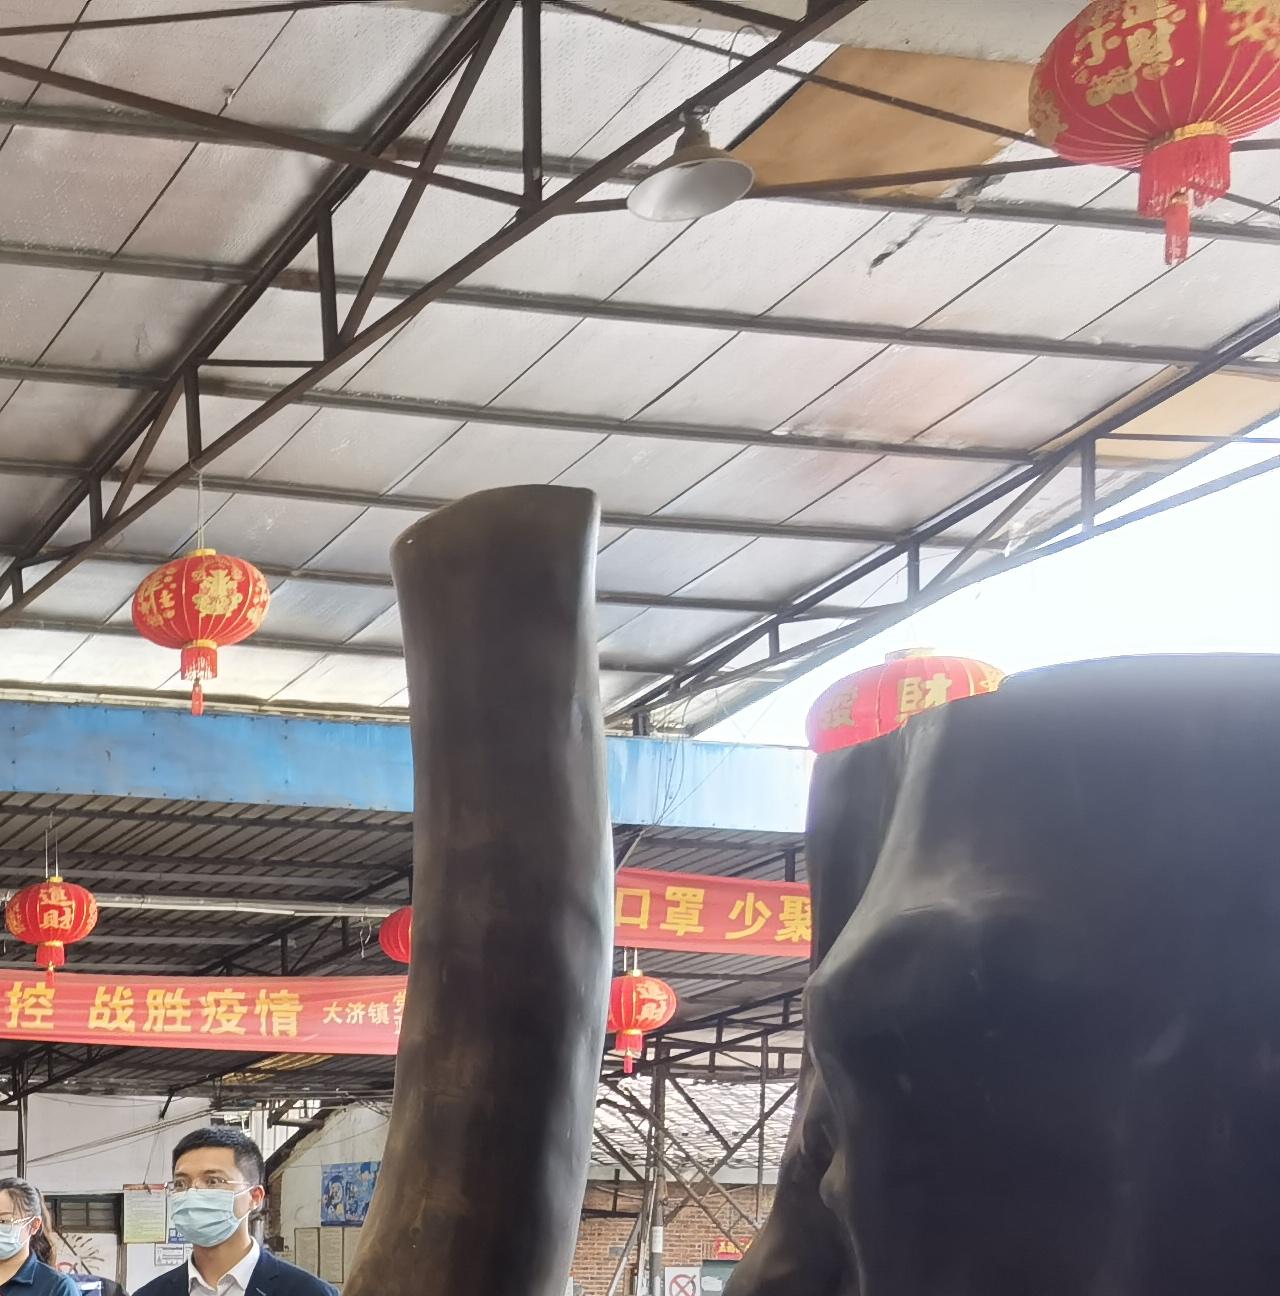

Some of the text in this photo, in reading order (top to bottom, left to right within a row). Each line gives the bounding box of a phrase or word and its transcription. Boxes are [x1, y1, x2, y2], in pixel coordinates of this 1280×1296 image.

[616, 886, 812, 942] 口罩 少聚
[88, 985, 304, 1037] 战胜疫情
[322, 1001, 390, 1025] 大济镇
